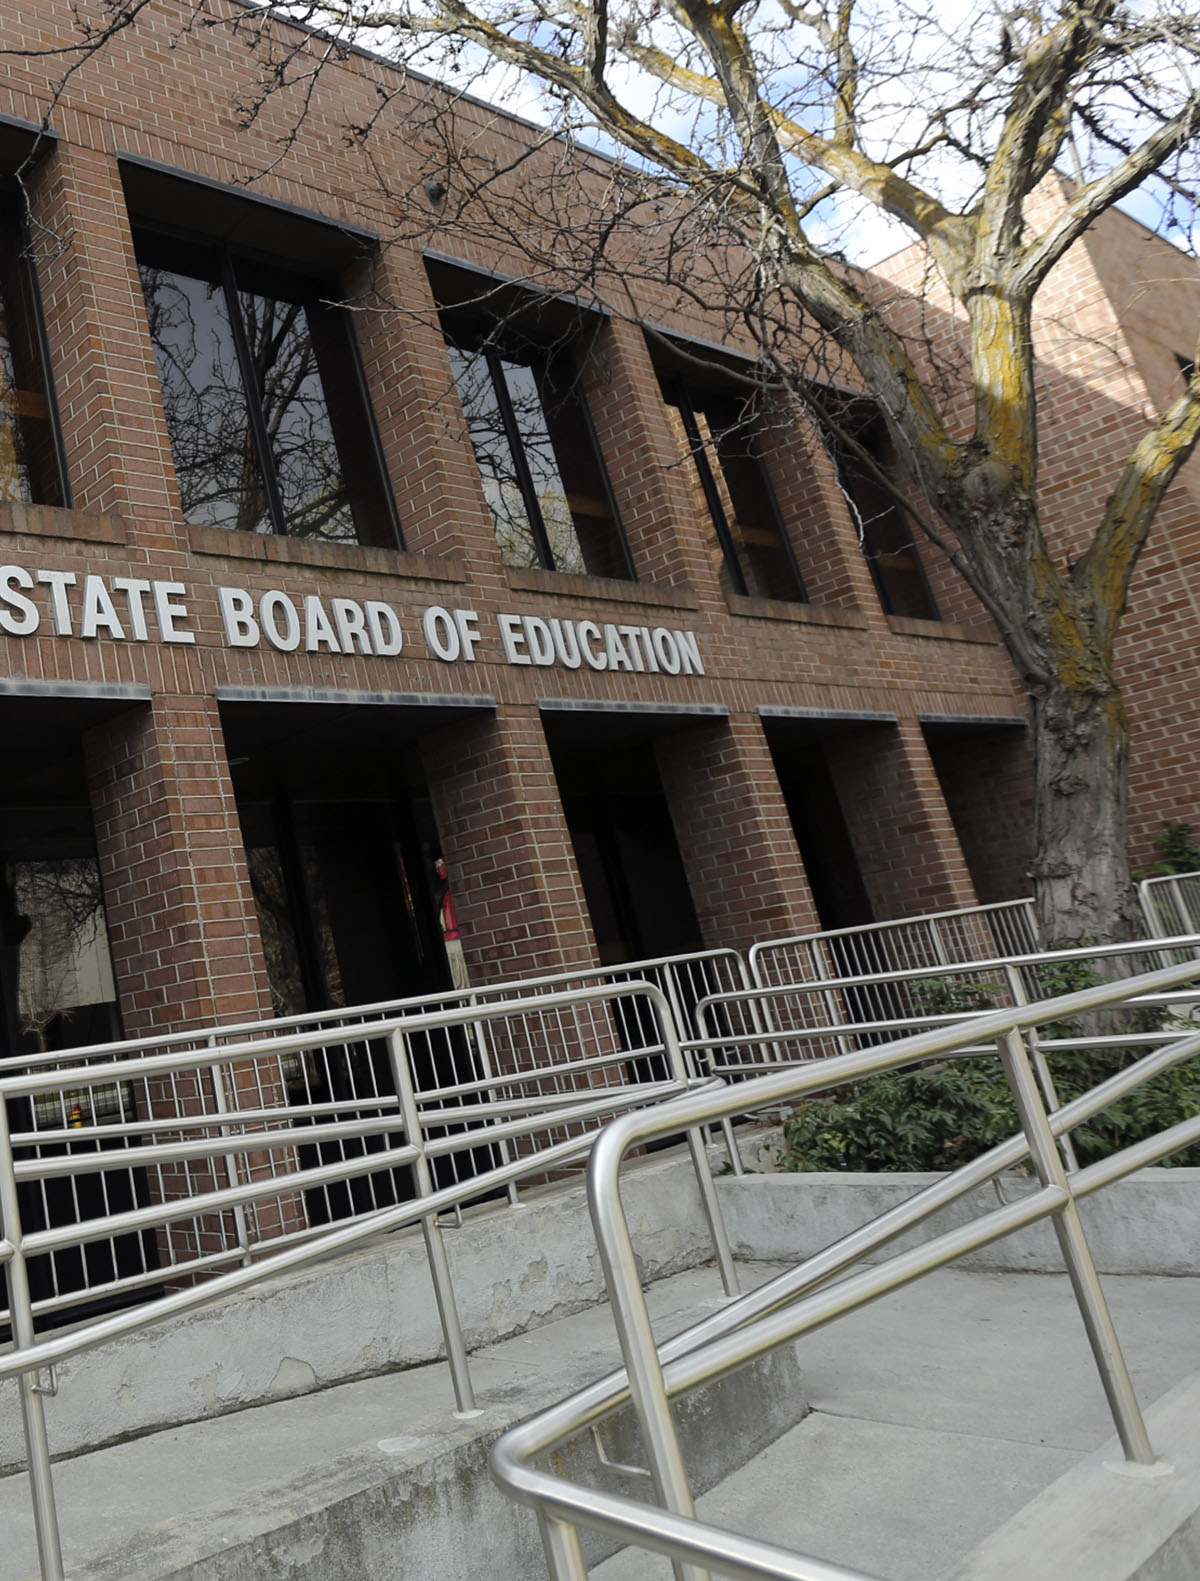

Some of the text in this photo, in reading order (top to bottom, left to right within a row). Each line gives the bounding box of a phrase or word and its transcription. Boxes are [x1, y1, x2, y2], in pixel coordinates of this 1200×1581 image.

[218, 586, 403, 657] BOARD
[422, 604, 482, 662] OF
[498, 612, 705, 676] EDUCATION
